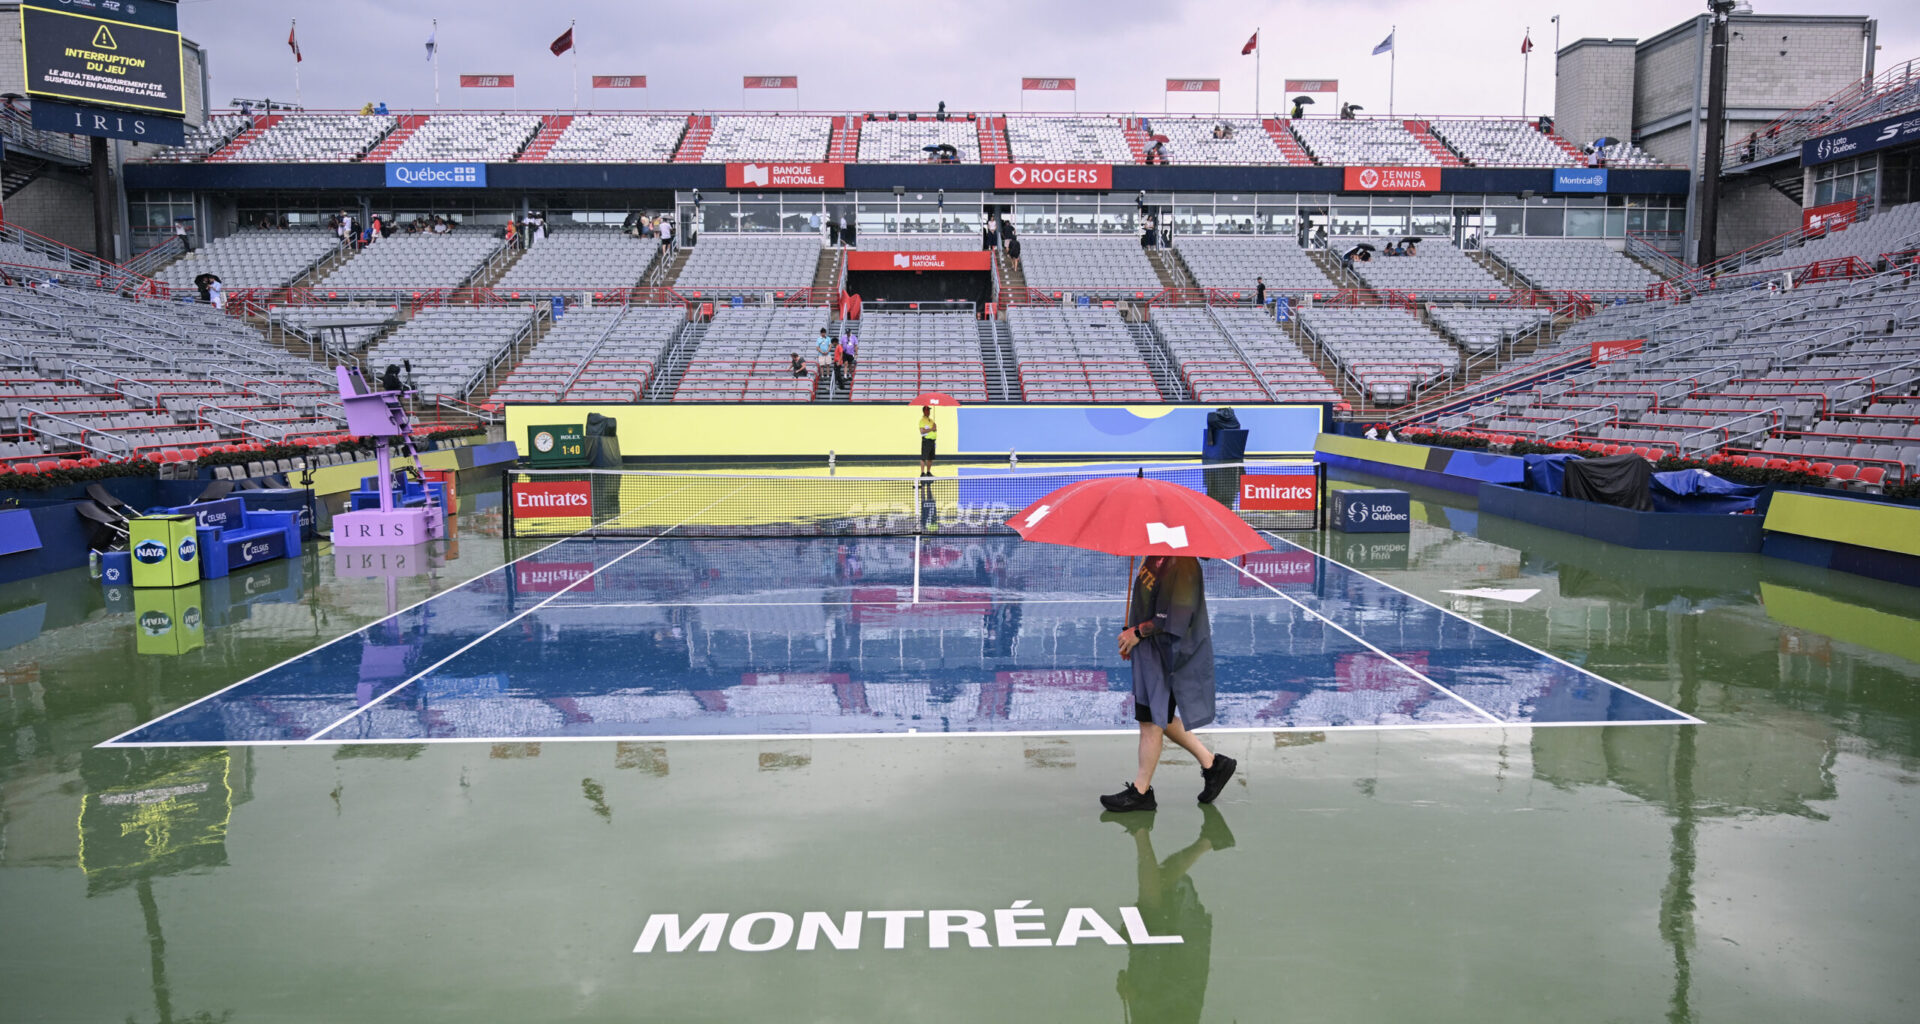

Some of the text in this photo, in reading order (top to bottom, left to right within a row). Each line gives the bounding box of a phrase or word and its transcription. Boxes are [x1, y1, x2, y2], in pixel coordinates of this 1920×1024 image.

[64, 48, 146, 67] INTERRUPTION
[86, 62, 127, 75] DU JEU
[59, 70, 75, 78] JEU
[81, 73, 148, 90] TEMPORAIREMENT
[148, 82, 163, 91] ÉTÉ
[44, 75, 85, 87] SUSPENDU
[96, 82, 125, 93] RAISON
[124, 86, 136, 94] DE
[135, 87, 146, 95] LA
[145, 89, 168, 99] PLUIE.
[74, 112, 146, 135] IRIS
[1833, 137, 1847, 146] Loto
[1832, 142, 1857, 154] Québec
[396, 167, 453, 183] Québec
[773, 166, 811, 175] BANQUE
[1030, 169, 1098, 183] ROGERS
[1382, 170, 1422, 179] TENNIS
[773, 176, 824, 185] NATIONALE
[1381, 179, 1426, 188] CANADA
[1560, 176, 1593, 185] Montréal
[562, 445, 580, 455] 1:40
[1244, 484, 1312, 499] Emirates
[517, 491, 588, 507] Emirates
[1371, 504, 1392, 513] Loto
[207, 512, 227, 522] CELSIUS
[1371, 512, 1407, 521] Québec
[344, 523, 404, 537] IRIS
[136, 549, 165, 557] NAYA
[180, 544, 195, 555] NAYA
[250, 543, 269, 554] CELSIUS
[632, 900, 1185, 953] MONTRÉAL
